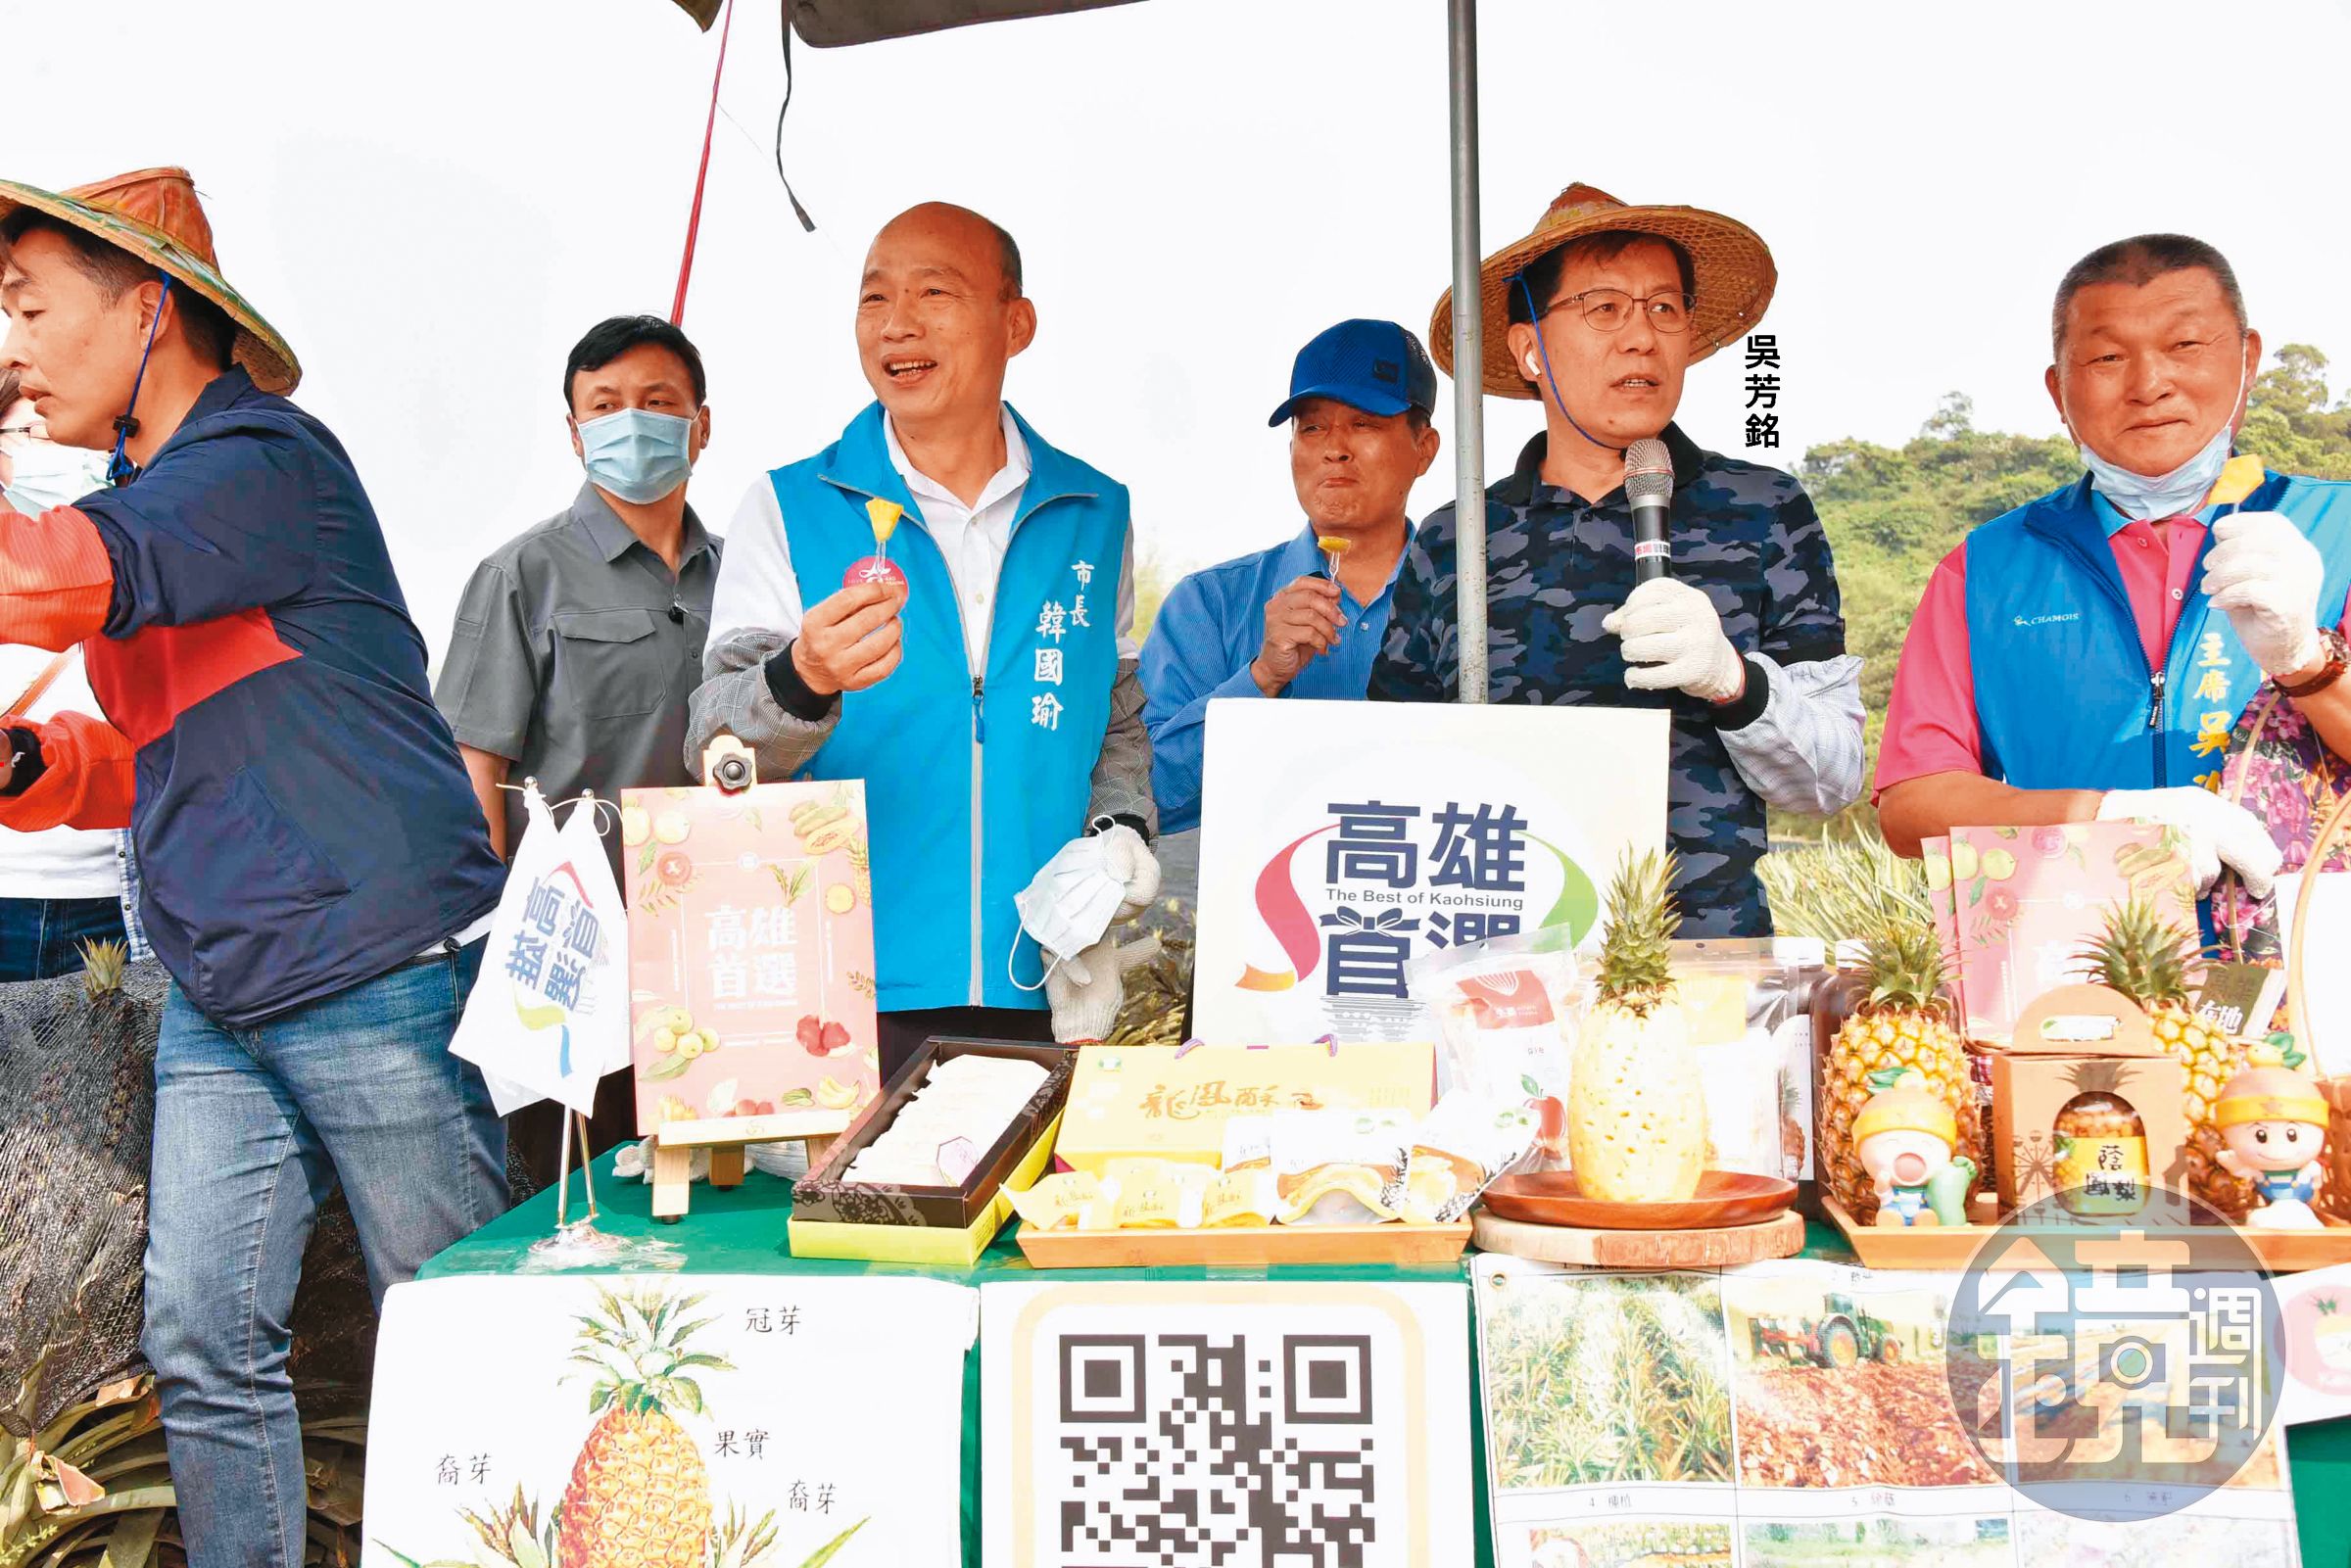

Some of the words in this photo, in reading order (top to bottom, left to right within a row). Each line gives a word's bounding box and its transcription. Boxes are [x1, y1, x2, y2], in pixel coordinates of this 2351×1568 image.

[1069, 559, 1095, 628] 市長
[2031, 612, 2080, 626] CHAMOIS
[1032, 599, 1068, 732] 韓國瑜
[1325, 800, 1528, 892] 高雄
[1325, 888, 1357, 902] The
[1363, 889, 1402, 903] Best
[1407, 892, 1424, 904] of
[1429, 892, 1524, 911] Kaohsiung
[704, 904, 799, 951] 高雄
[705, 952, 797, 998] 首選
[745, 1305, 801, 1336] 冠芽
[714, 1427, 771, 1461] 果實
[437, 1452, 493, 1486] 裔芽
[788, 1479, 838, 1515] 裔芽
